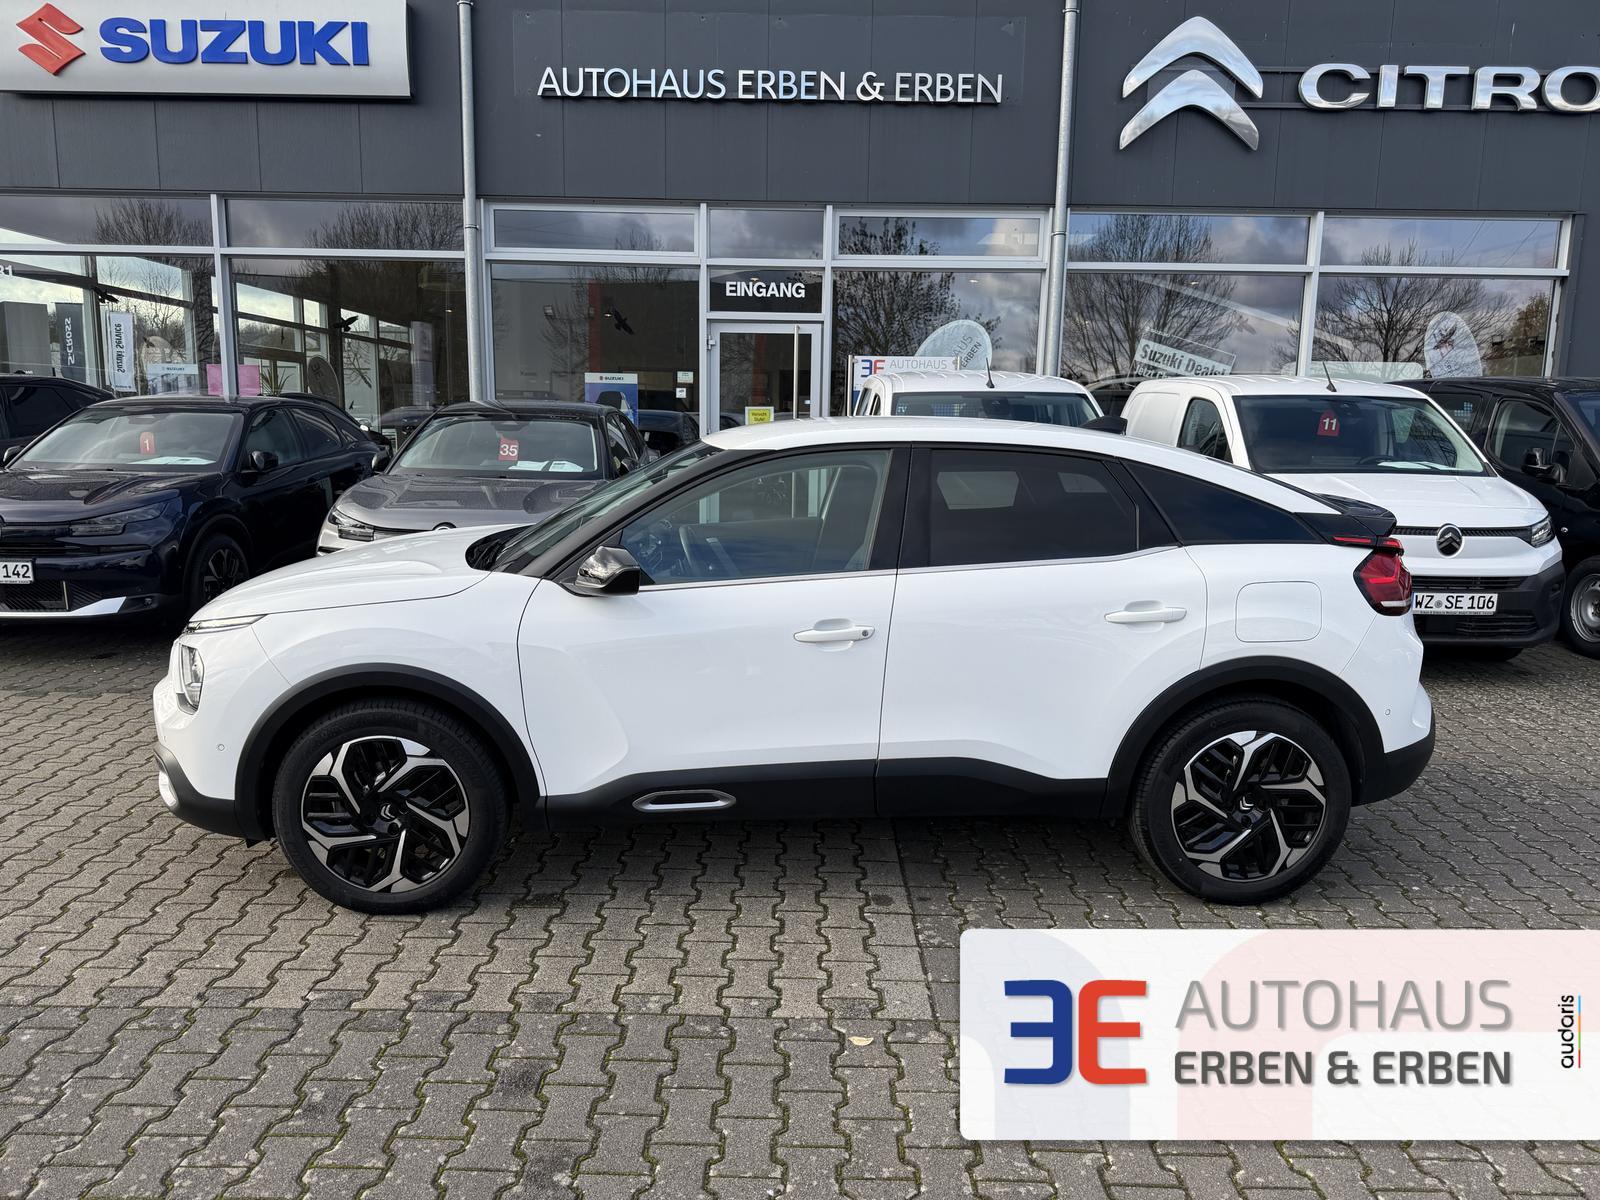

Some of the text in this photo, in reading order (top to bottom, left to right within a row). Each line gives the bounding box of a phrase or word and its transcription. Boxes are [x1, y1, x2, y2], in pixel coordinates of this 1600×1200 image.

[99, 17, 369, 66] SUZUKI
[537, 67, 1003, 103] AUTOHAUS ERBEN & ERBEN
[1298, 63, 1600, 112] CITRO
[725, 281, 806, 298] EINGANG
[889, 359, 948, 370] AUTOHAUS
[1140, 343, 1184, 370] Suzuki
[1322, 417, 1337, 431] 11
[143, 439, 150, 452] 1
[500, 444, 518, 457] 35
[2, 564, 31, 579] 142
[1415, 594, 1495, 610] WZ SE 106
